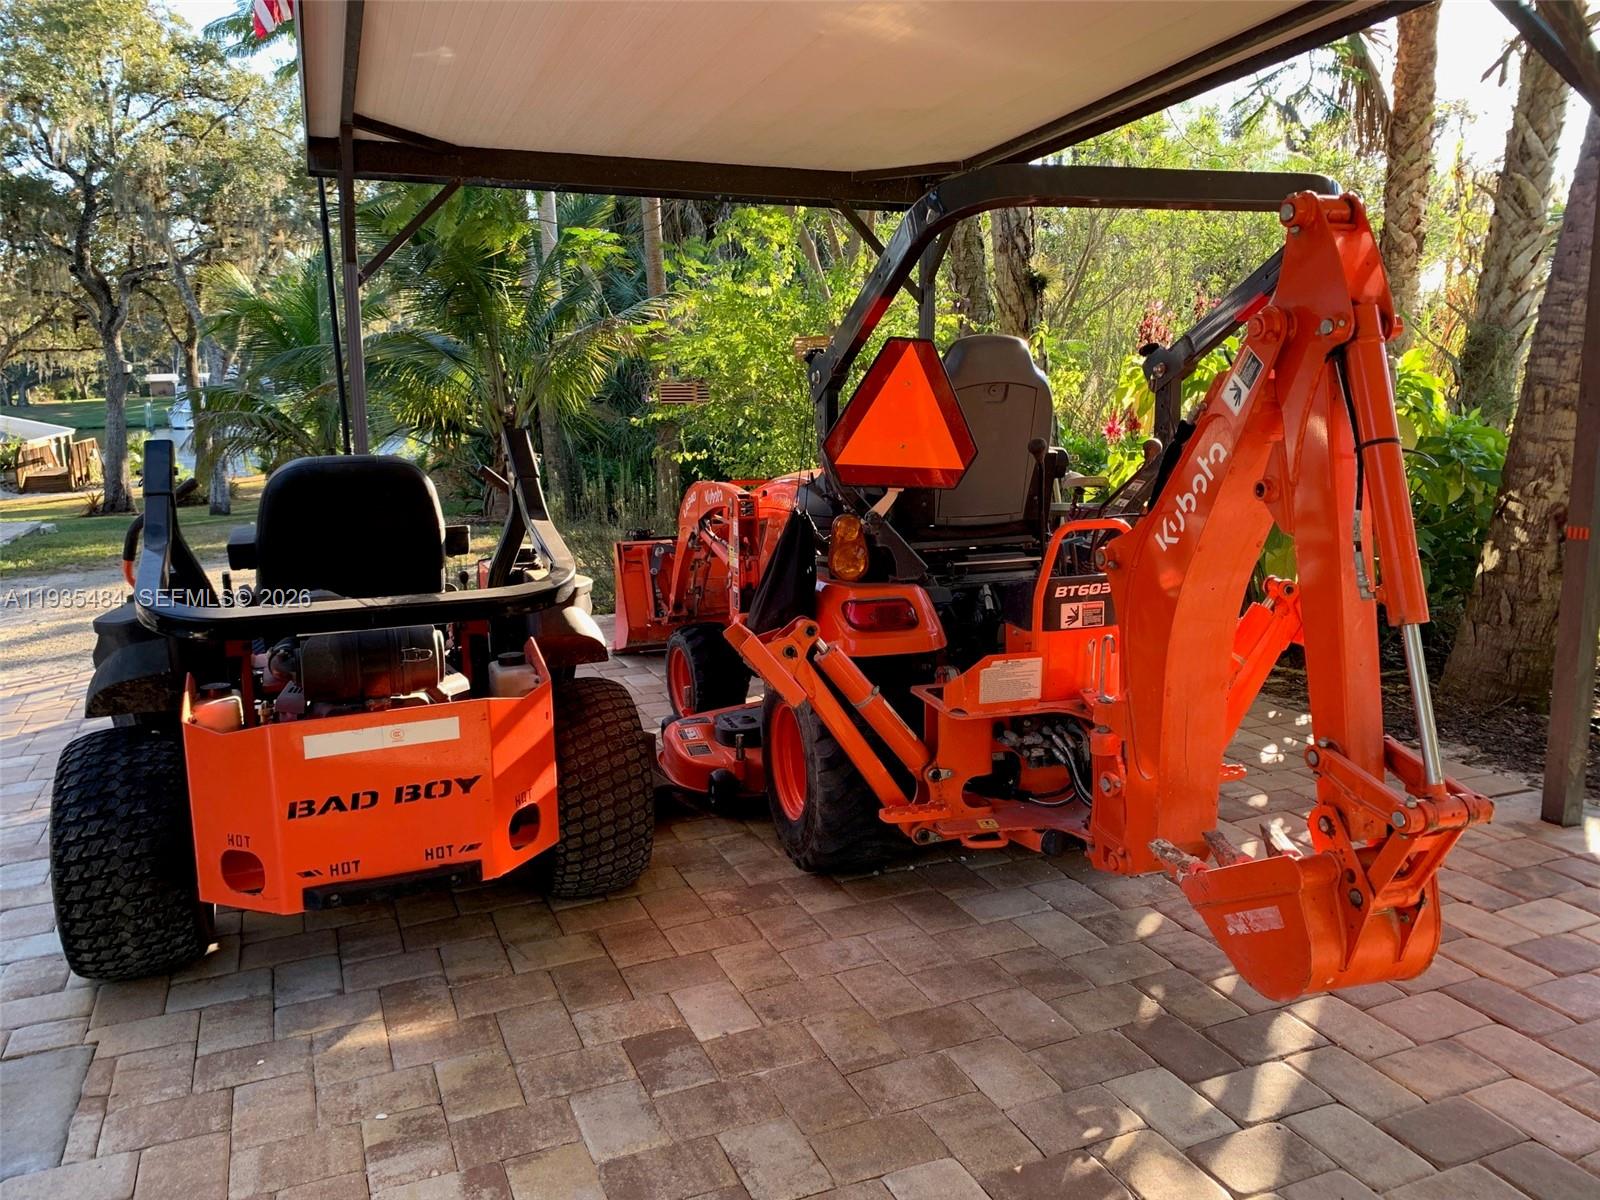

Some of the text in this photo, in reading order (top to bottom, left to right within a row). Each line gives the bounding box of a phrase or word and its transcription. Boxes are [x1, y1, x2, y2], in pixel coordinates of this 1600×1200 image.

[1155, 442, 1228, 551] Kubota
[1055, 582, 1111, 598] BT603
[287, 775, 482, 820] BAD BOY
[514, 788, 534, 807] HOT
[227, 833, 251, 848] HOT
[424, 845, 454, 861] HOT
[329, 860, 361, 877] HOT
